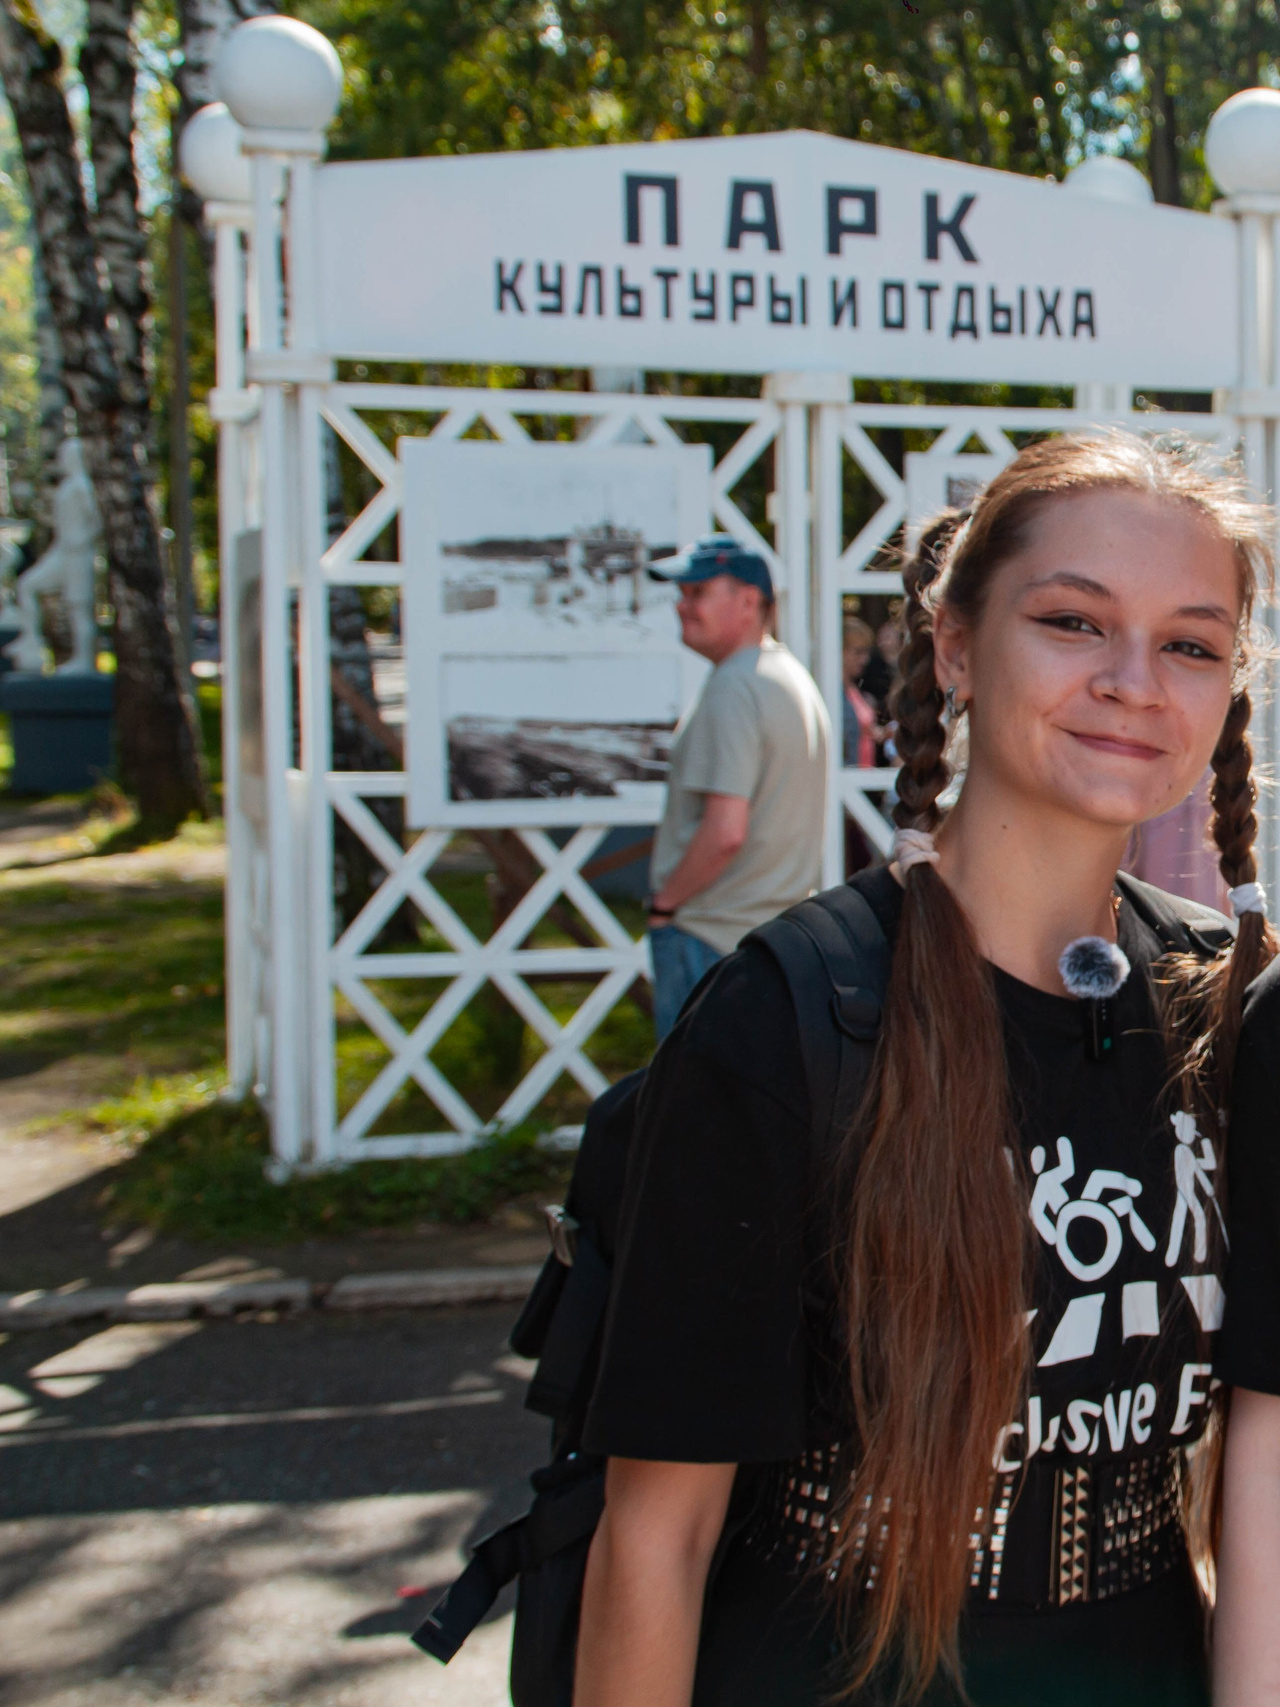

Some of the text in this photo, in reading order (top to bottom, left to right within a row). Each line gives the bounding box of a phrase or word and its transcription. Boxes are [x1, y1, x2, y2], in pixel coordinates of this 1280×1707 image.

[623, 172, 979, 264] ПАРК
[495, 259, 1097, 341] КУЛЬТУРЫ И ОТДЫХА
